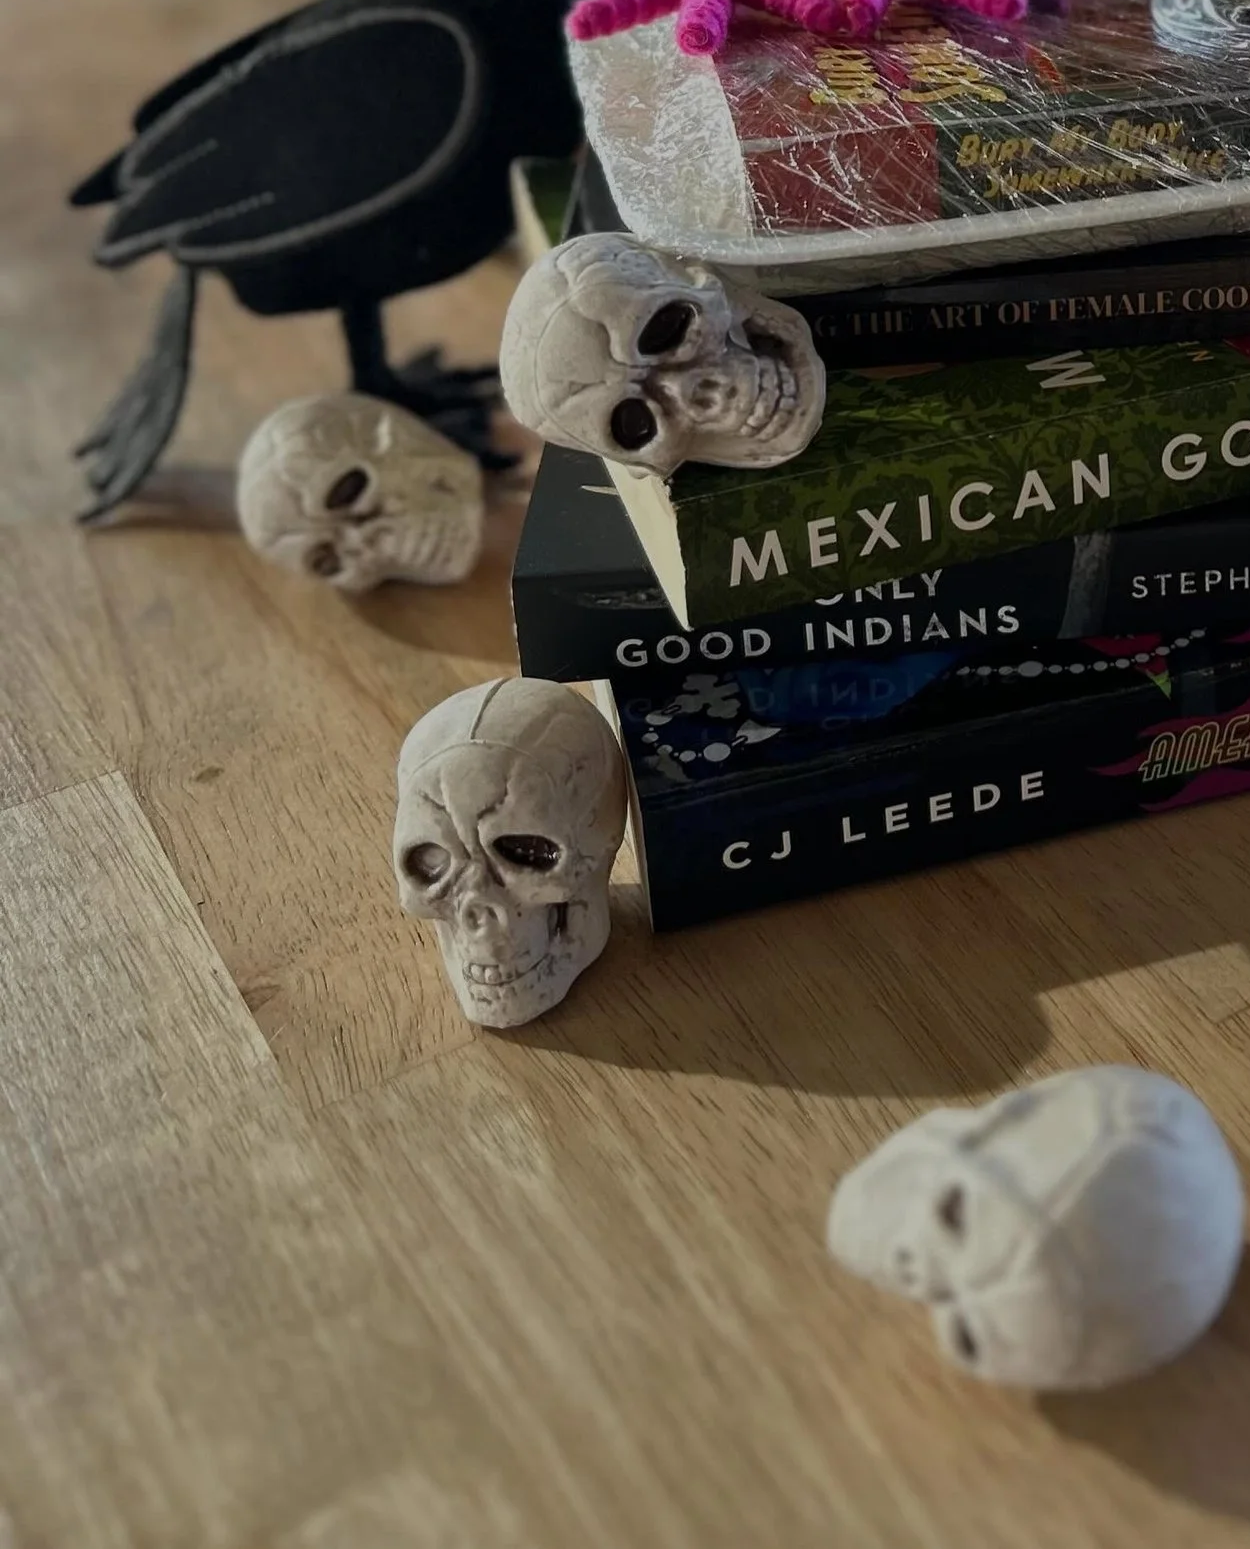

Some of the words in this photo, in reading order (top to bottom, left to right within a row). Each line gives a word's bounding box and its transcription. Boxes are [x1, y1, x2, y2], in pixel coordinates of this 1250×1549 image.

[846, 309, 914, 337] THE
[926, 303, 989, 331] ART
[998, 299, 1038, 326] OF
[1048, 289, 1177, 322] FEMALE
[728, 452, 1111, 588] MEXICAN
[814, 568, 943, 606] NLY
[616, 628, 772, 668] GOOD
[804, 605, 1021, 652] INDIANS
[722, 830, 792, 871] CJ
[842, 770, 1046, 845] LEEDE
